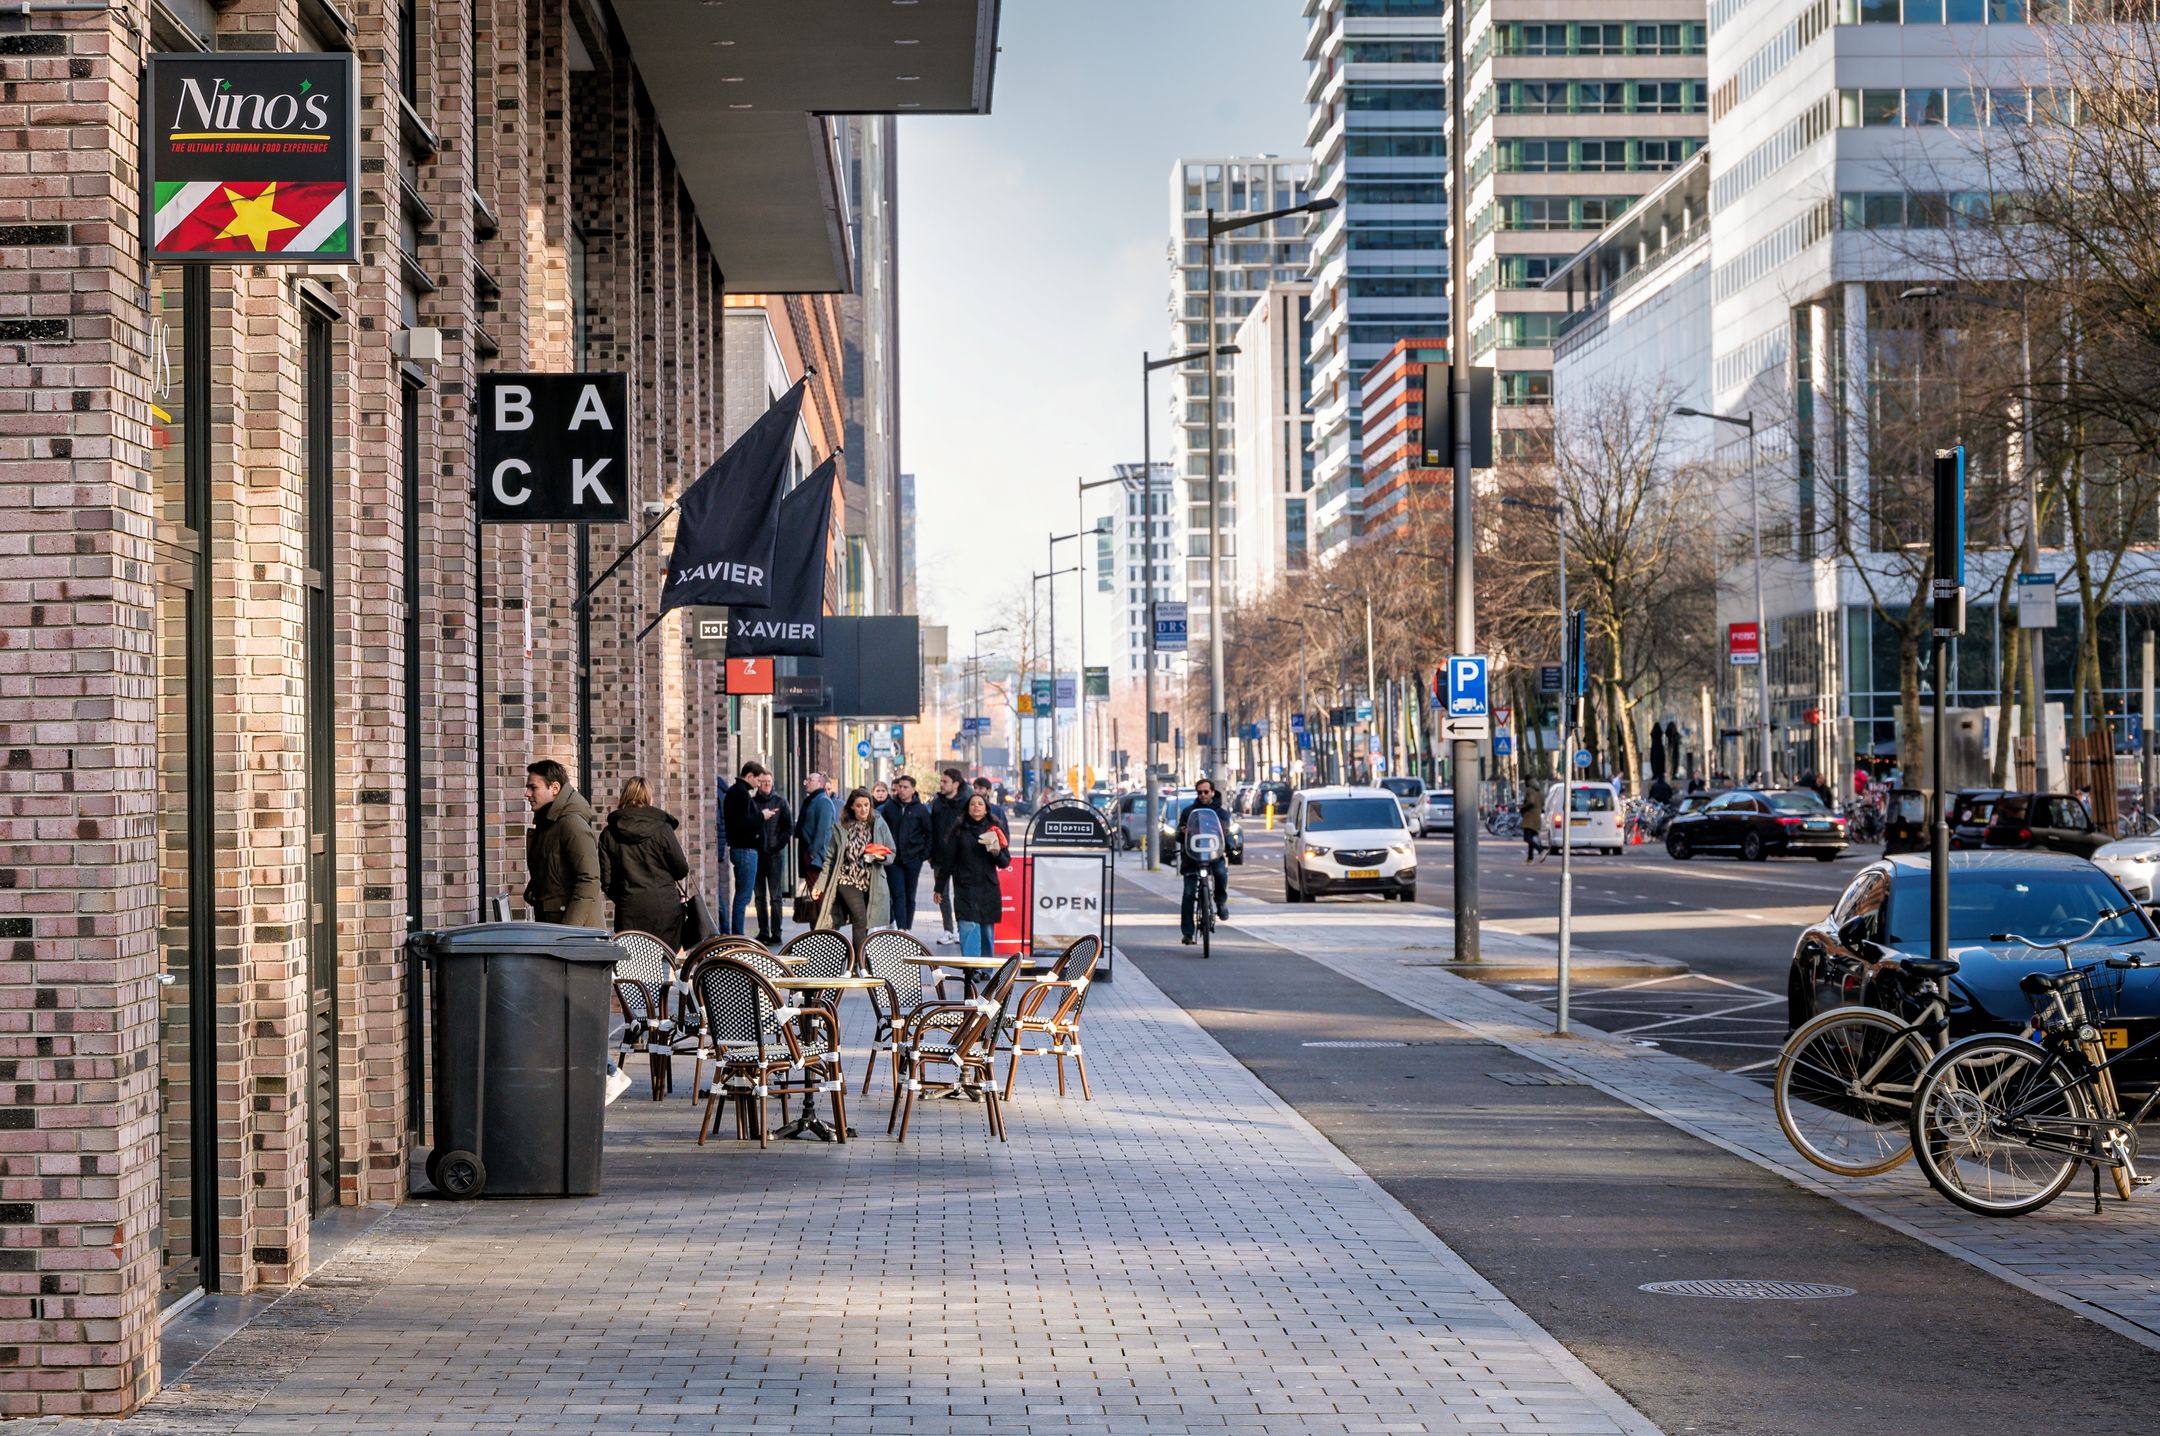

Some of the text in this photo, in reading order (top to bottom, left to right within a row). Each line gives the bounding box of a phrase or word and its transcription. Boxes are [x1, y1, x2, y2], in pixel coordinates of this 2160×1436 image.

[170, 78, 330, 130] Nino's
[171, 143, 328, 153] THE ULTIMATE SURINAM FOOD EXPERIENCE
[675, 562, 764, 587] XAVIER
[704, 626, 719, 634] XO
[736, 619, 816, 640] XAVIER
[1732, 631, 1757, 640] FEBO
[1457, 661, 1479, 692] P
[1039, 895, 1098, 911] OPEN
